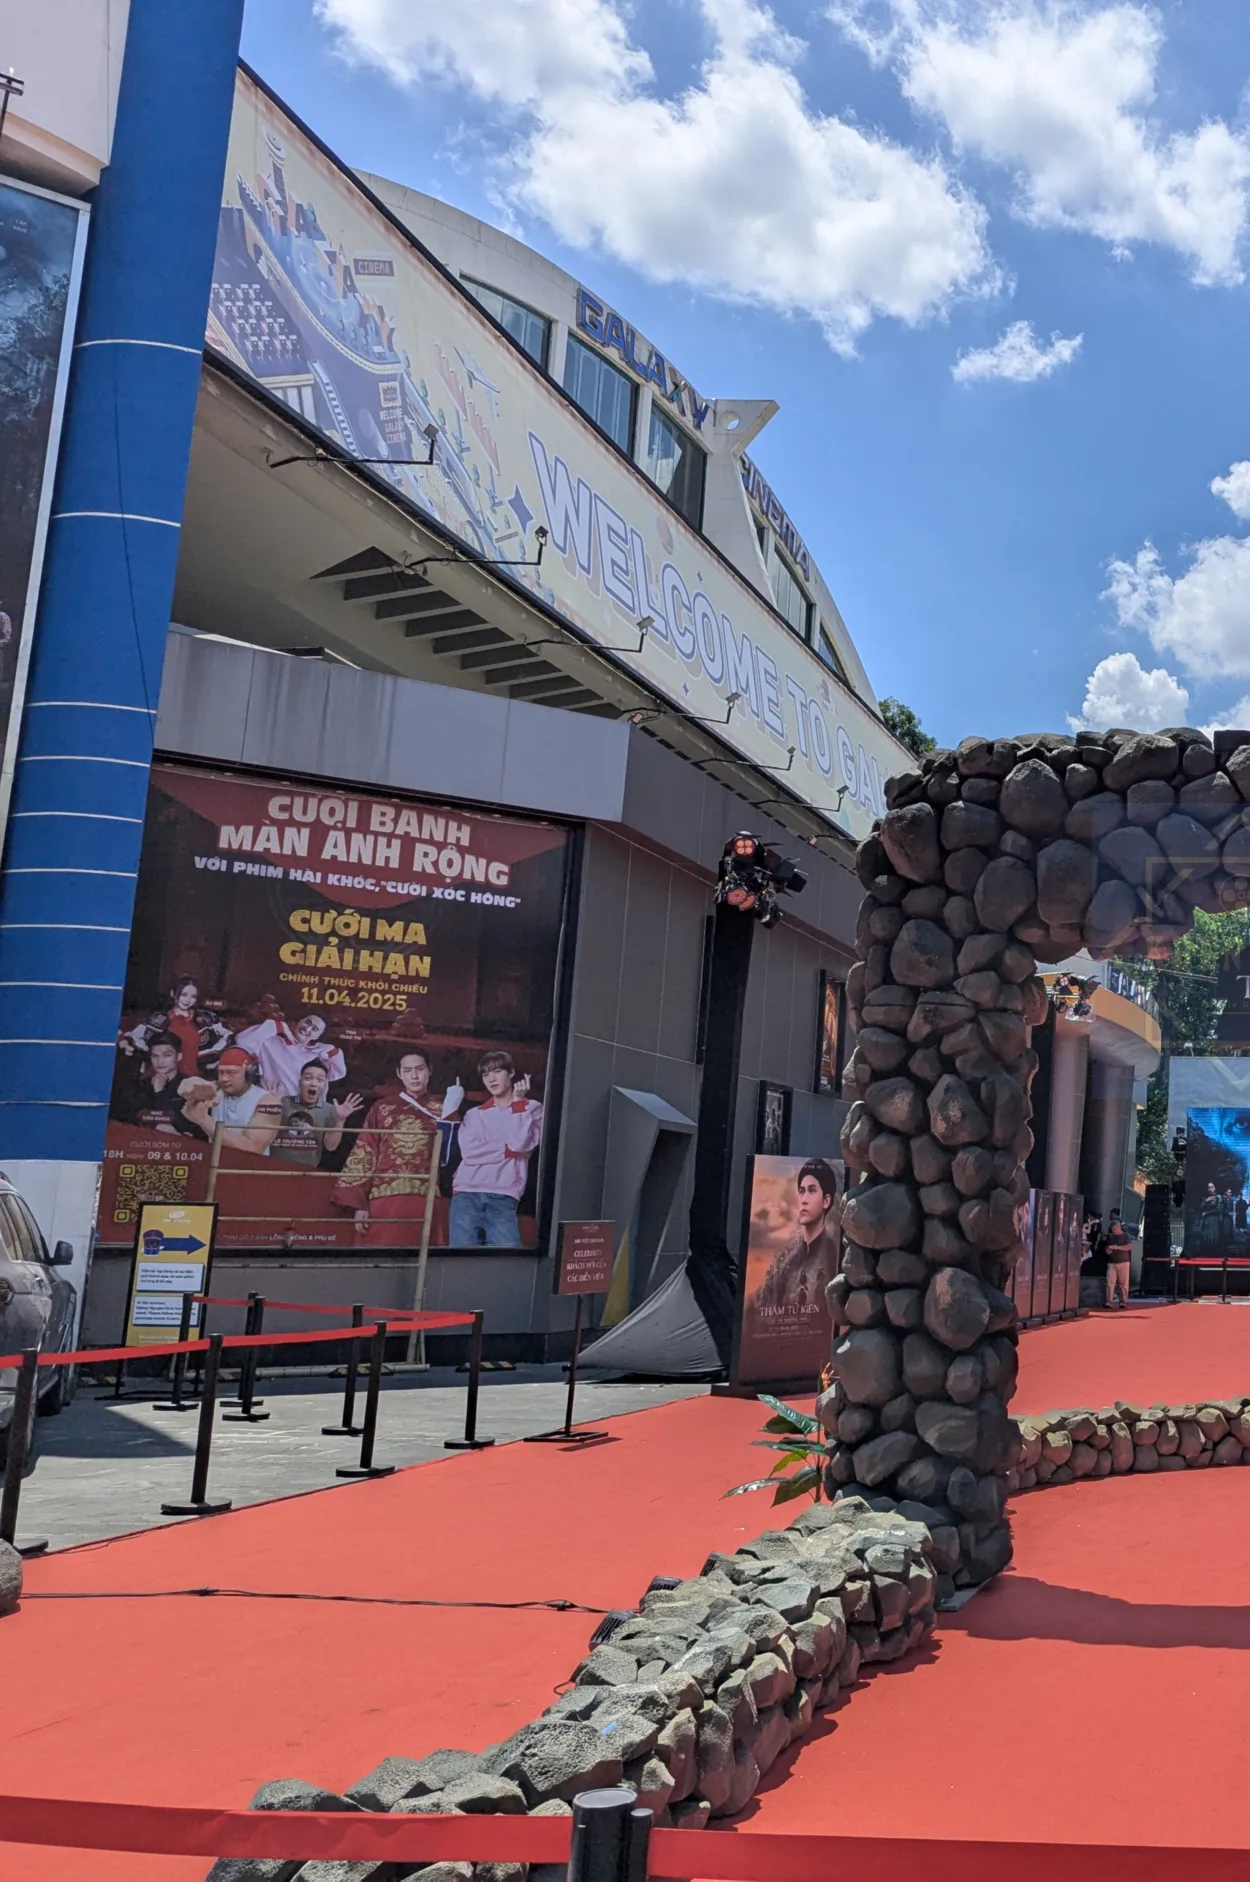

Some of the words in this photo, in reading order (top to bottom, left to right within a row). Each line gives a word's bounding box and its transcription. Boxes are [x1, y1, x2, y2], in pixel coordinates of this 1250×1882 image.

[357, 260, 391, 275] CINEMA
[576, 288, 709, 430] GALAXY
[528, 430, 785, 741] WELCOME
[785, 672, 832, 776] TO
[370, 803, 470, 847] BANH
[194, 856, 227, 872] VỚI
[233, 861, 284, 879] PHIM
[218, 819, 310, 857] MÀN
[320, 822, 401, 868] ẢNH
[412, 844, 509, 886] RỘNG
[289, 908, 371, 940] CƯỚI
[375, 919, 427, 945] MA
[279, 937, 354, 970] GIẢI
[358, 950, 431, 980] HẠN
[279, 971, 319, 984] CHÍNH
[323, 974, 355, 988] THỨC
[391, 982, 428, 994] CHIẾU
[301, 987, 408, 1011] 11.04.2025
[103, 1149, 124, 1159] 18H
[147, 1151, 160, 1160] 09
[163, 1152, 172, 1160] &
[175, 1152, 203, 1161] 10.04
[759, 1304, 785, 1317] THÁM
[786, 1302, 800, 1315] TỬ
[800, 1303, 820, 1314] KIÊN
